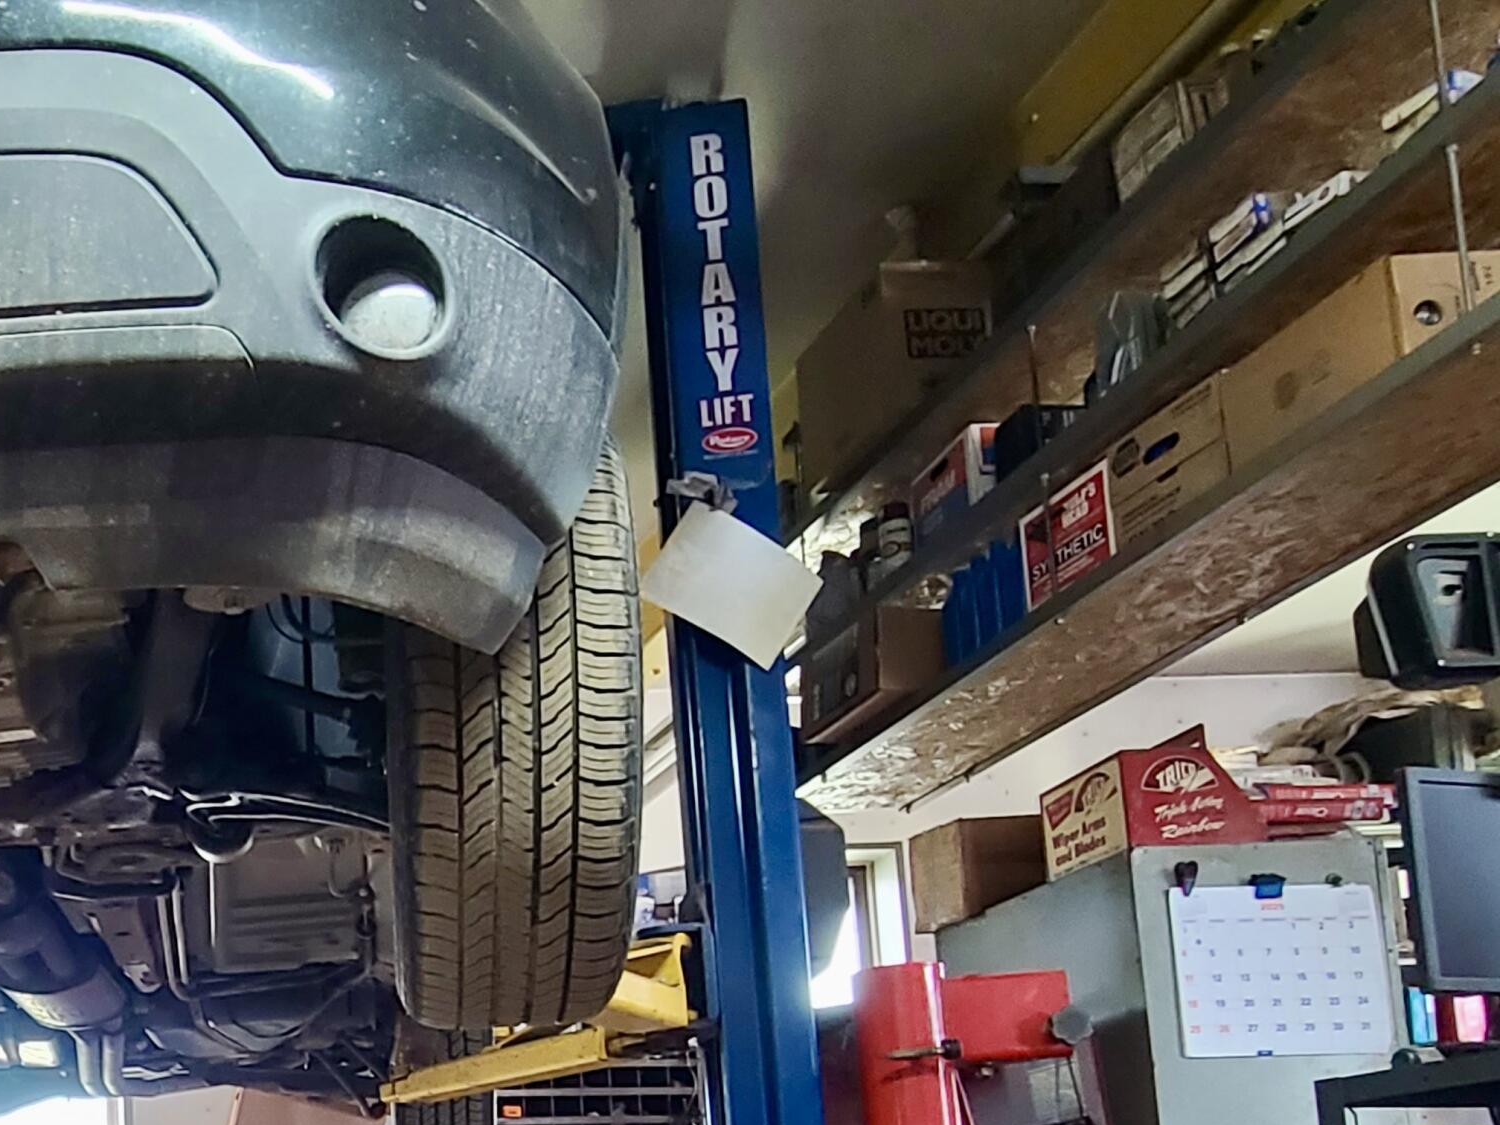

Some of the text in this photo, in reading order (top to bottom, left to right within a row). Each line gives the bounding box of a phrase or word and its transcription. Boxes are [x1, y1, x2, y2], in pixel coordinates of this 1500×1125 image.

[690, 133, 740, 392] ROTARY
[906, 310, 983, 331] LIQUI
[700, 393, 755, 428] LIFT
[1031, 523, 1104, 581] SYTHETIC
